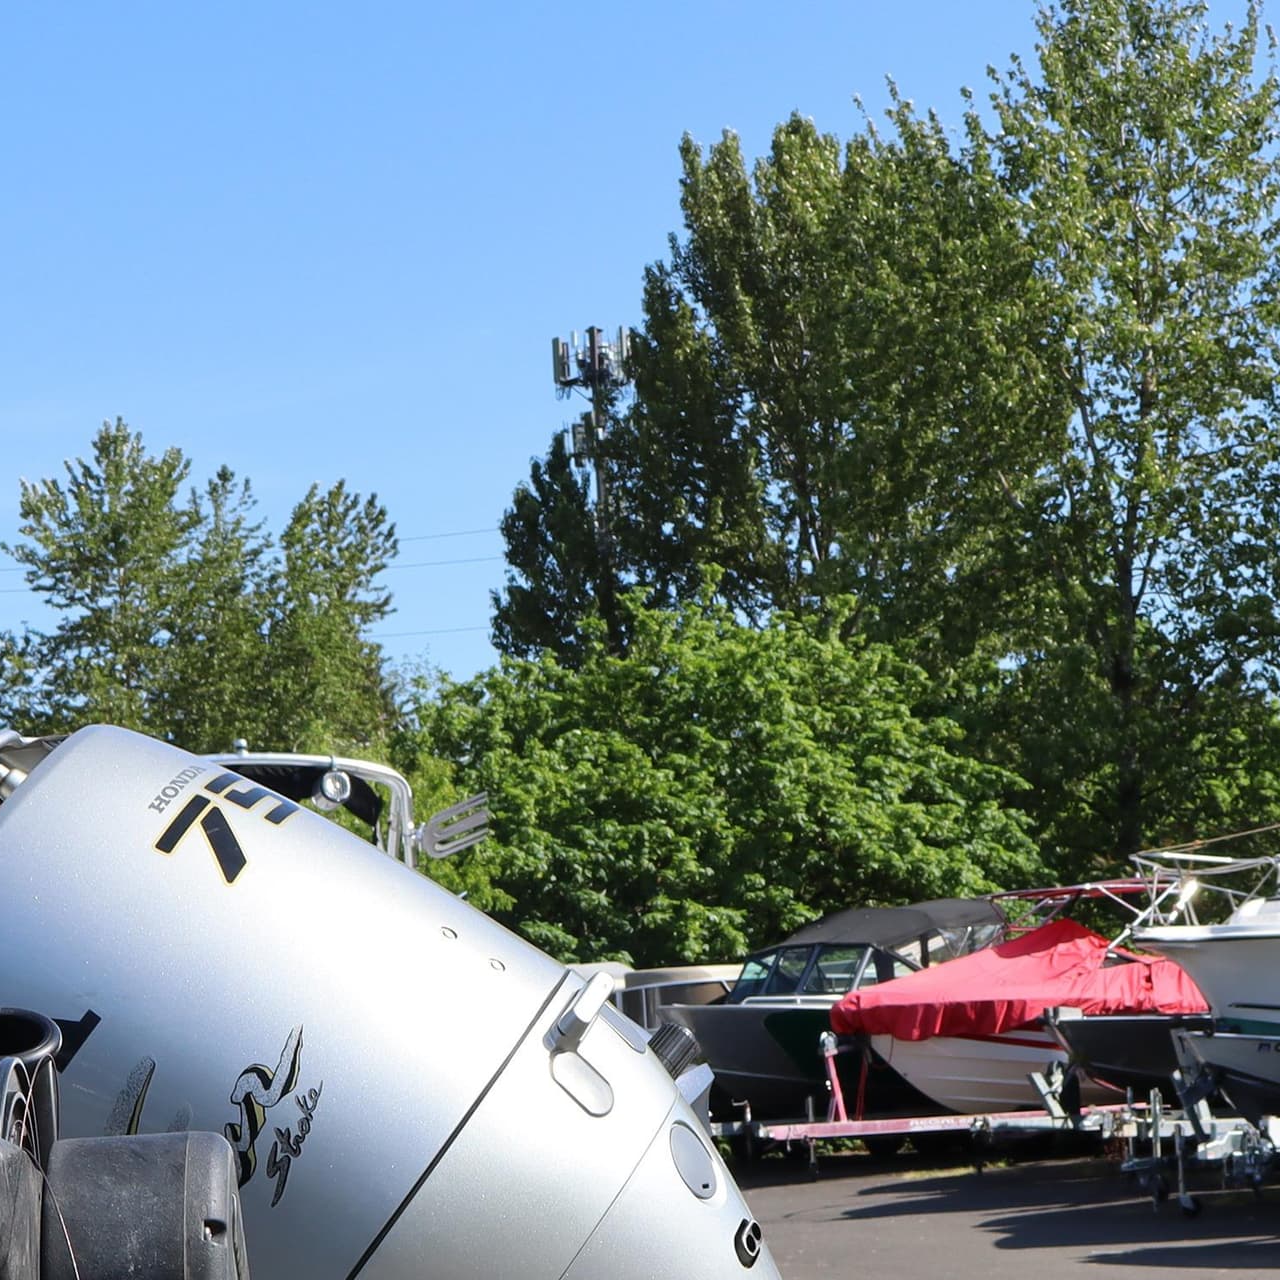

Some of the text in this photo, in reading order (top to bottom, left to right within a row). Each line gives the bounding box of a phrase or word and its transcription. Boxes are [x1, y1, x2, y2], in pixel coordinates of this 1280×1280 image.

[148, 765, 207, 814] HONDA
[153, 771, 301, 885] 75
[267, 1079, 324, 1208] Stroke
